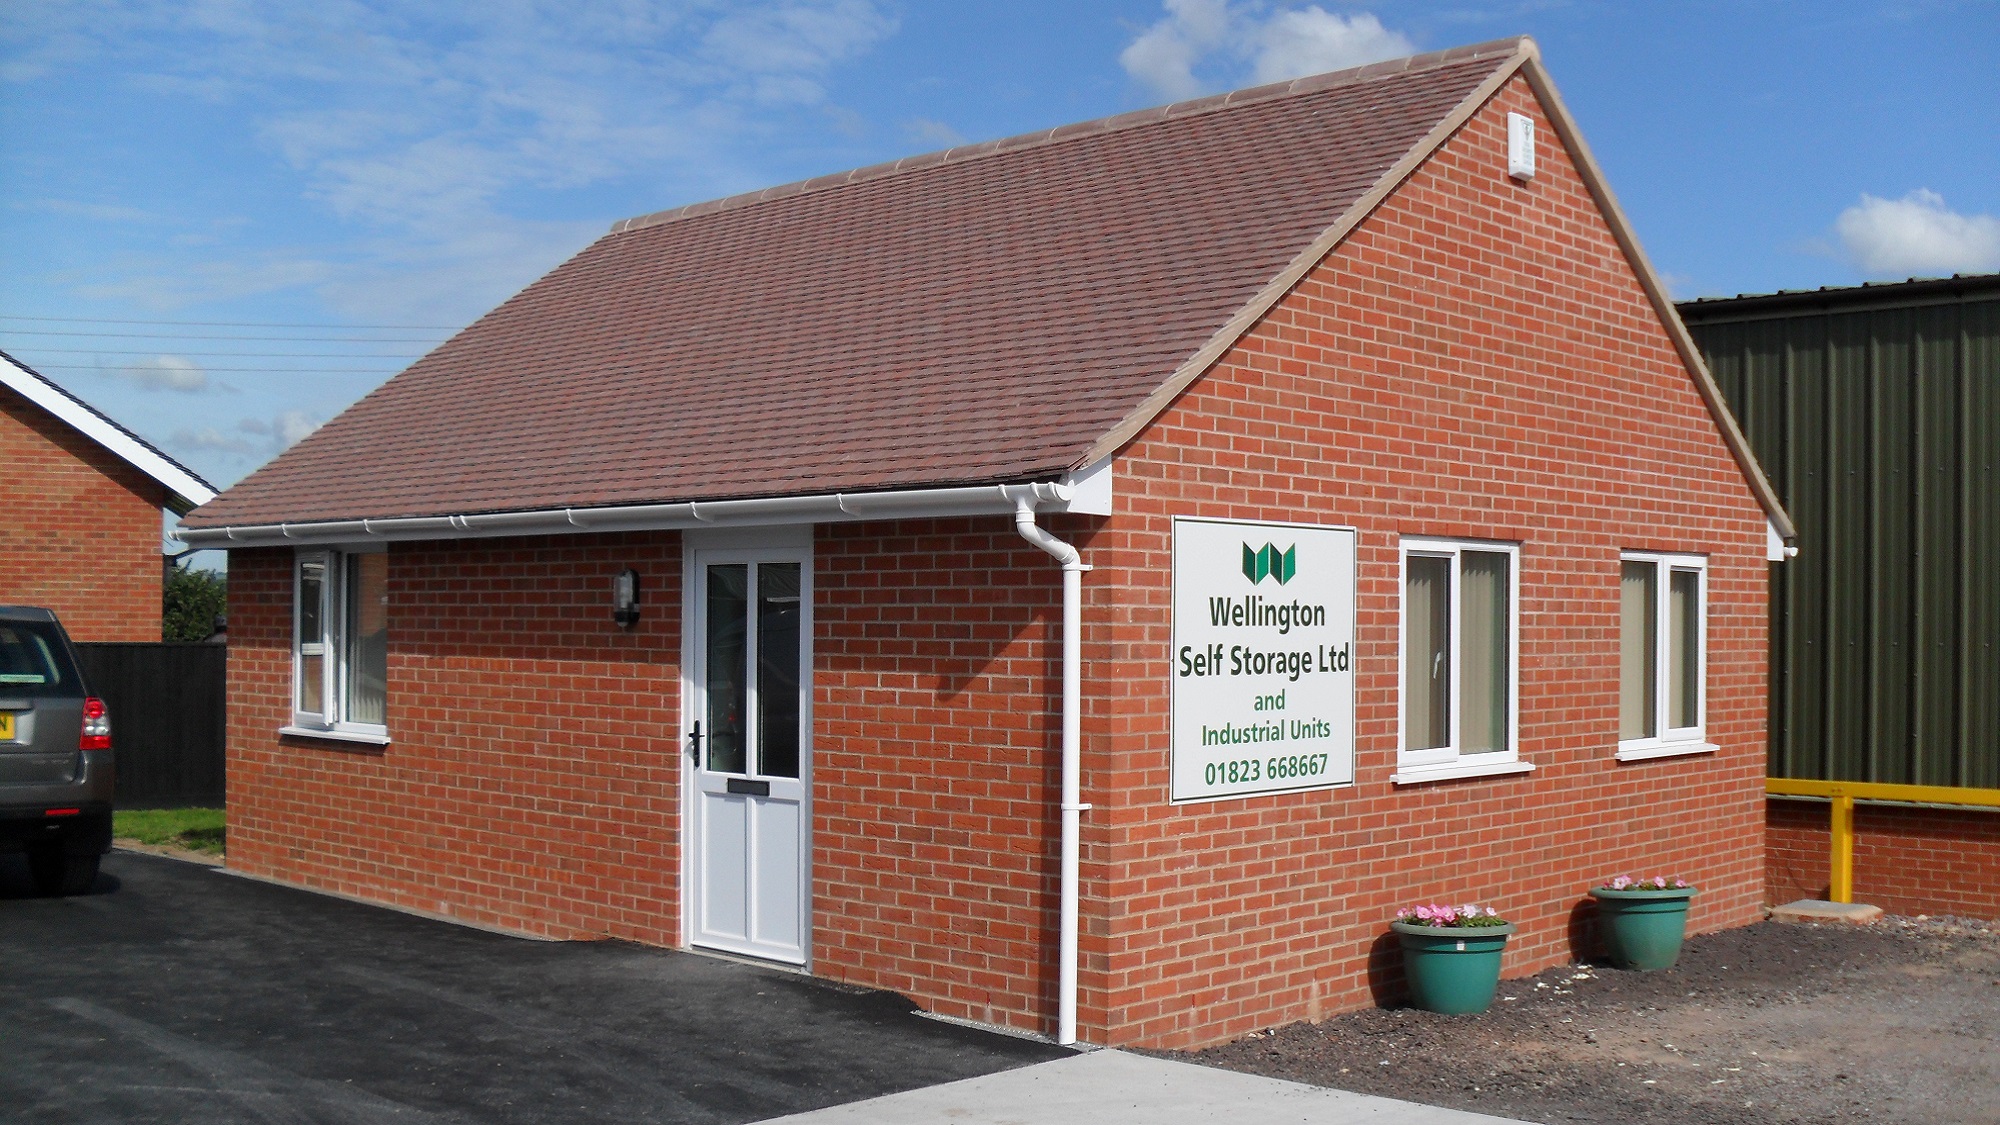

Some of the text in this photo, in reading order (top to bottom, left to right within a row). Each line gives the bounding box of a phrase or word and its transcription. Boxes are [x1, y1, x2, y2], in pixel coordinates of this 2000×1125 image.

[1209, 594, 1325, 635] Wellington
[1179, 642, 1349, 681] Self Storage Ltd
[1253, 688, 1286, 712] and
[1202, 717, 1331, 747] Industrial Units
[1205, 753, 1328, 786] 01823 668667
